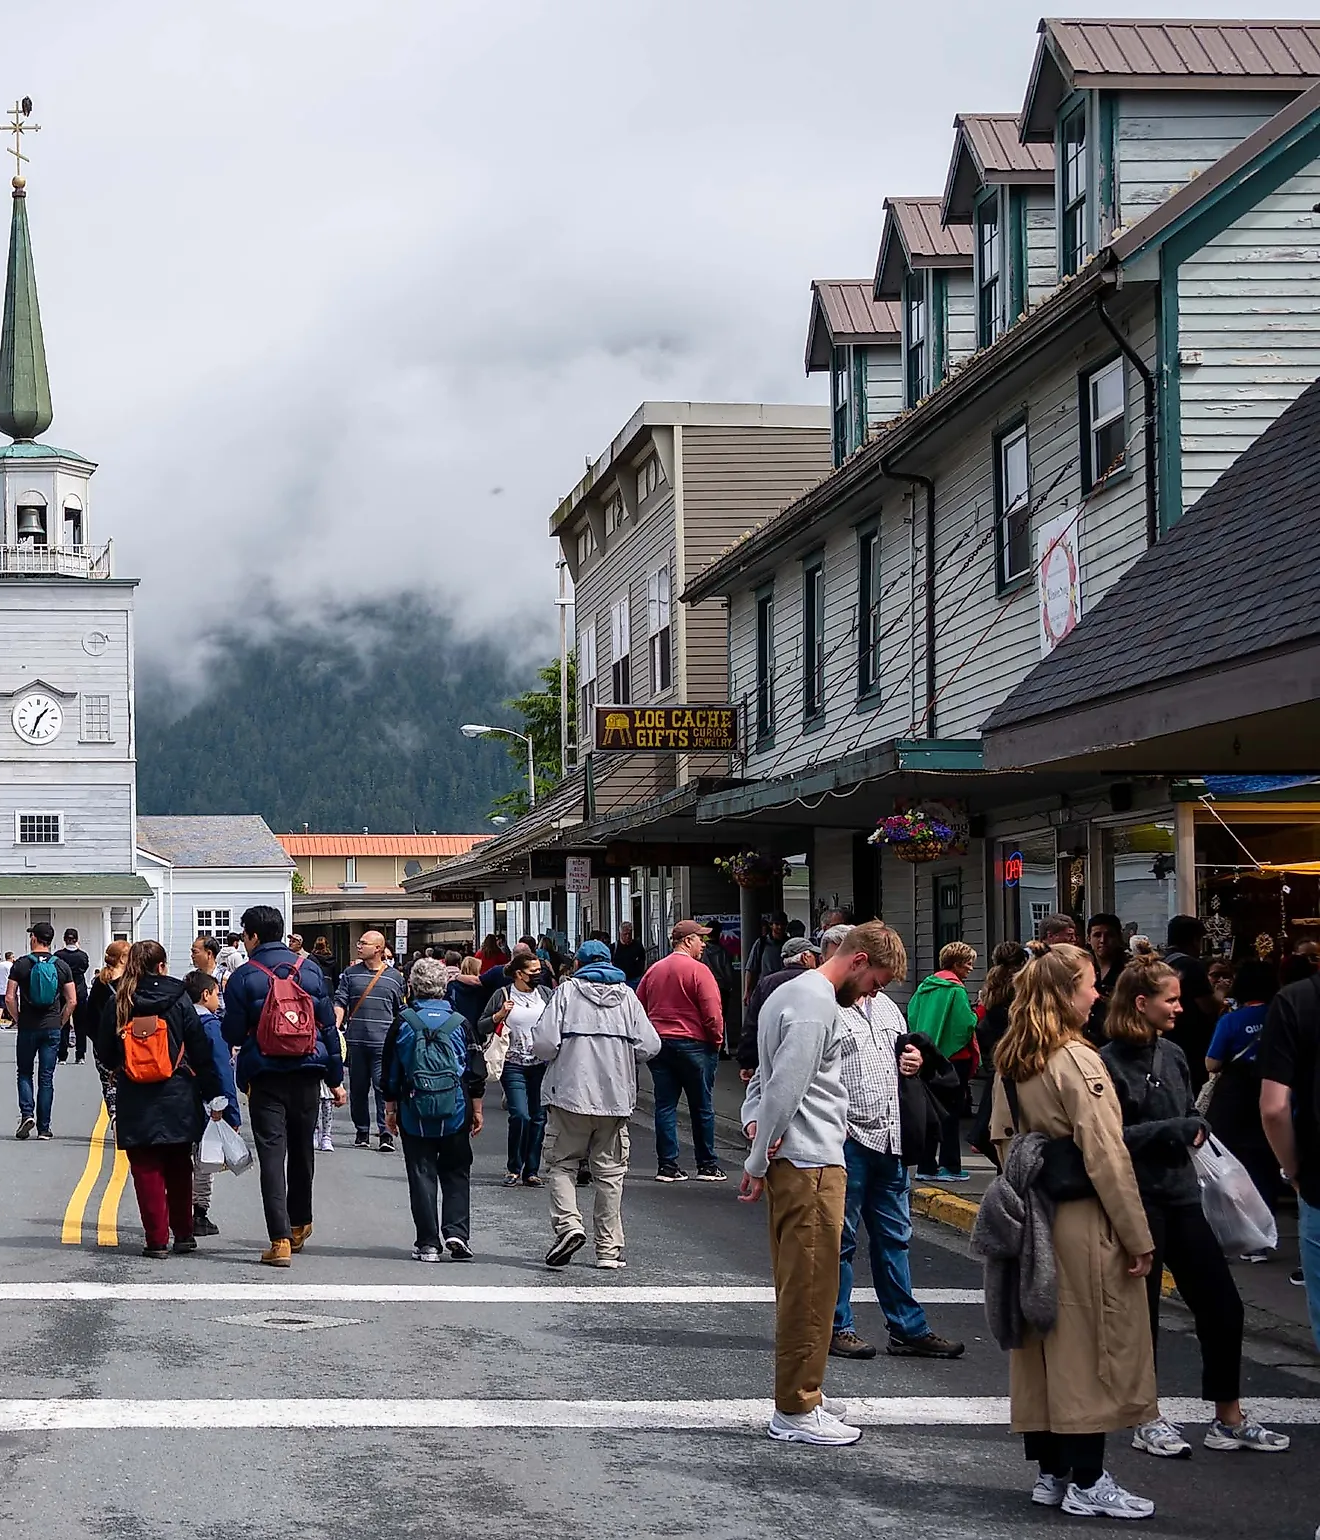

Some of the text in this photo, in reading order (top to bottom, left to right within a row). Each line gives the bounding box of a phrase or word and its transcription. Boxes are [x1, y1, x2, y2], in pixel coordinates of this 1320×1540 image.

[634, 710, 732, 728] LOG CACHE
[636, 729, 689, 747] GIFTS
[693, 728, 728, 738] CURIOS
[692, 737, 733, 748] JEWELRY
